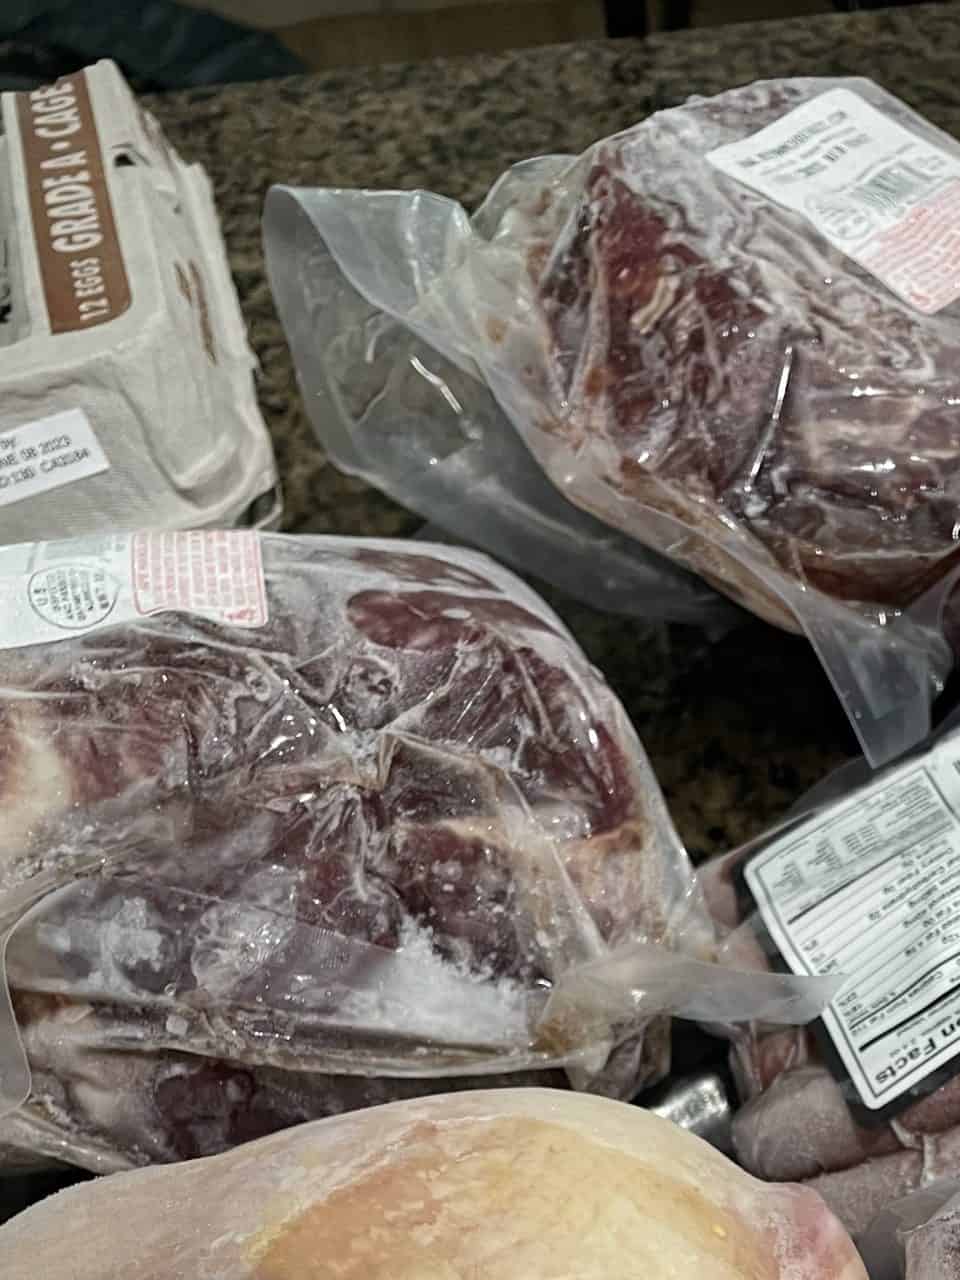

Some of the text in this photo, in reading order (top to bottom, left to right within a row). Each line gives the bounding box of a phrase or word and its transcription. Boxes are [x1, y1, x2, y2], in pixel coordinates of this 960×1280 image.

[40, 151, 87, 170] A
[45, 172, 102, 254] GRADE
[69, 254, 106, 303] EGGS
[79, 303, 109, 322] 12
[873, 1034, 937, 1090] Facts
